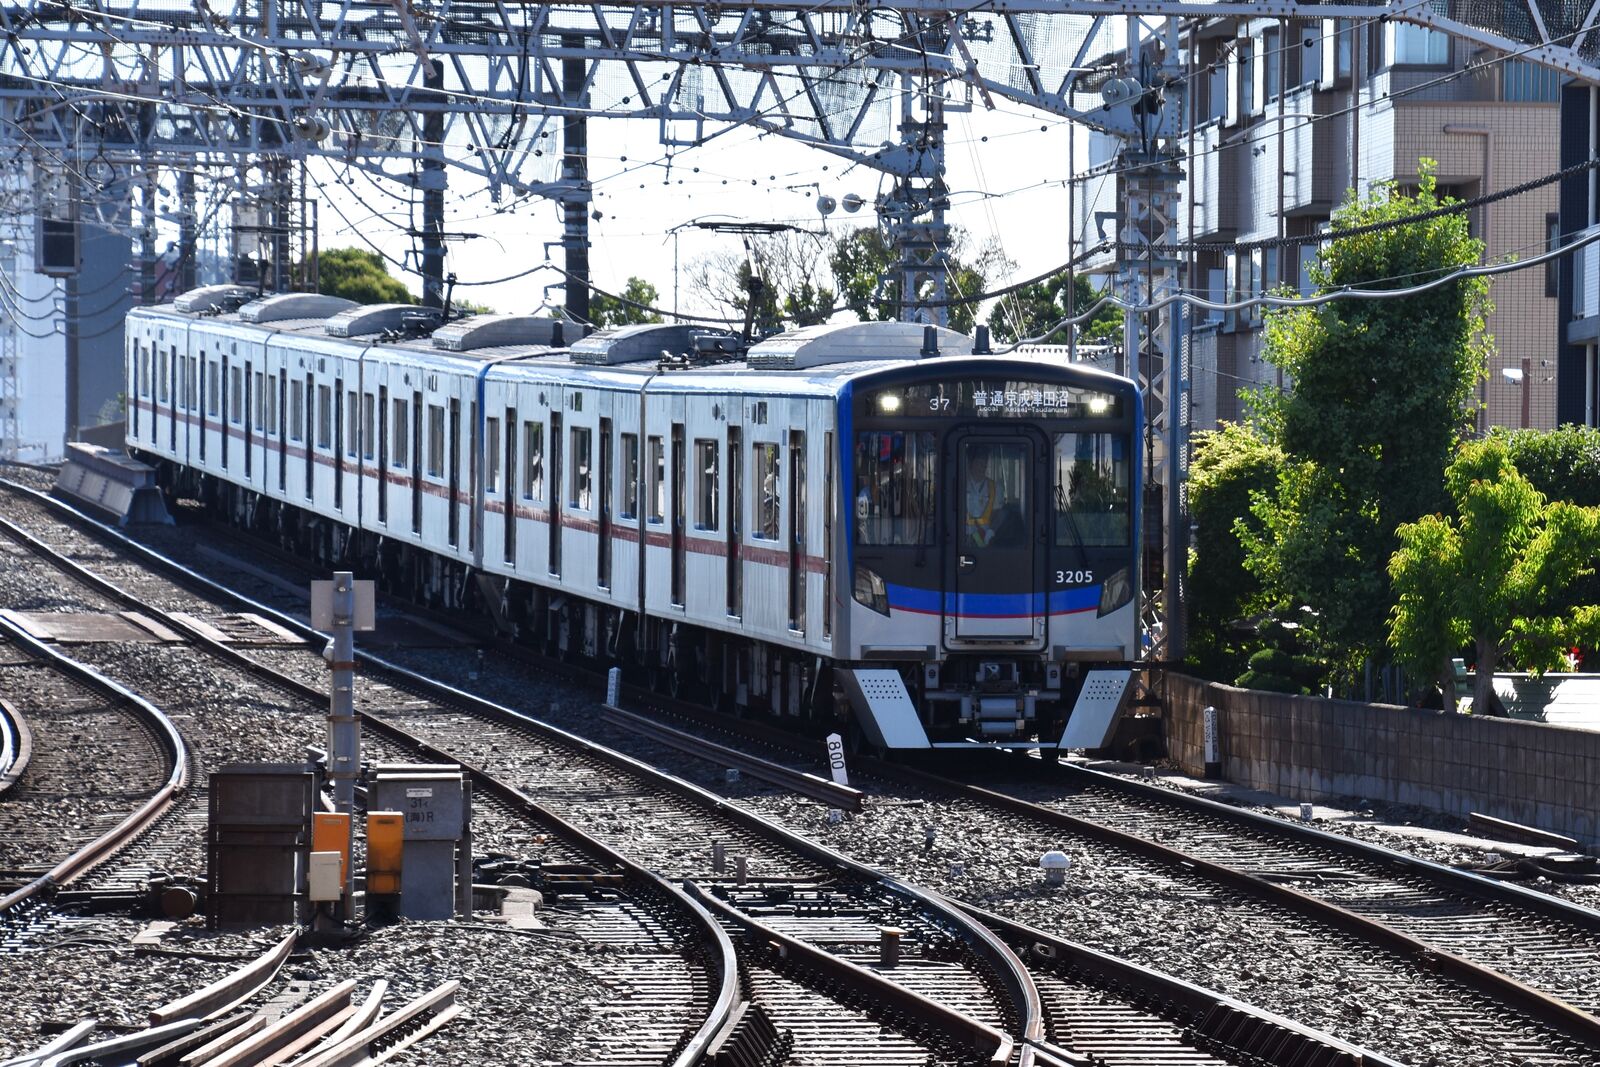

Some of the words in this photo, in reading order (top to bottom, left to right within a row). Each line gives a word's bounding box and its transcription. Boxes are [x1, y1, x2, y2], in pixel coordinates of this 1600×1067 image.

[929, 398, 950, 411] 37
[1055, 570, 1093, 583] 3205
[828, 741, 845, 769] 800
